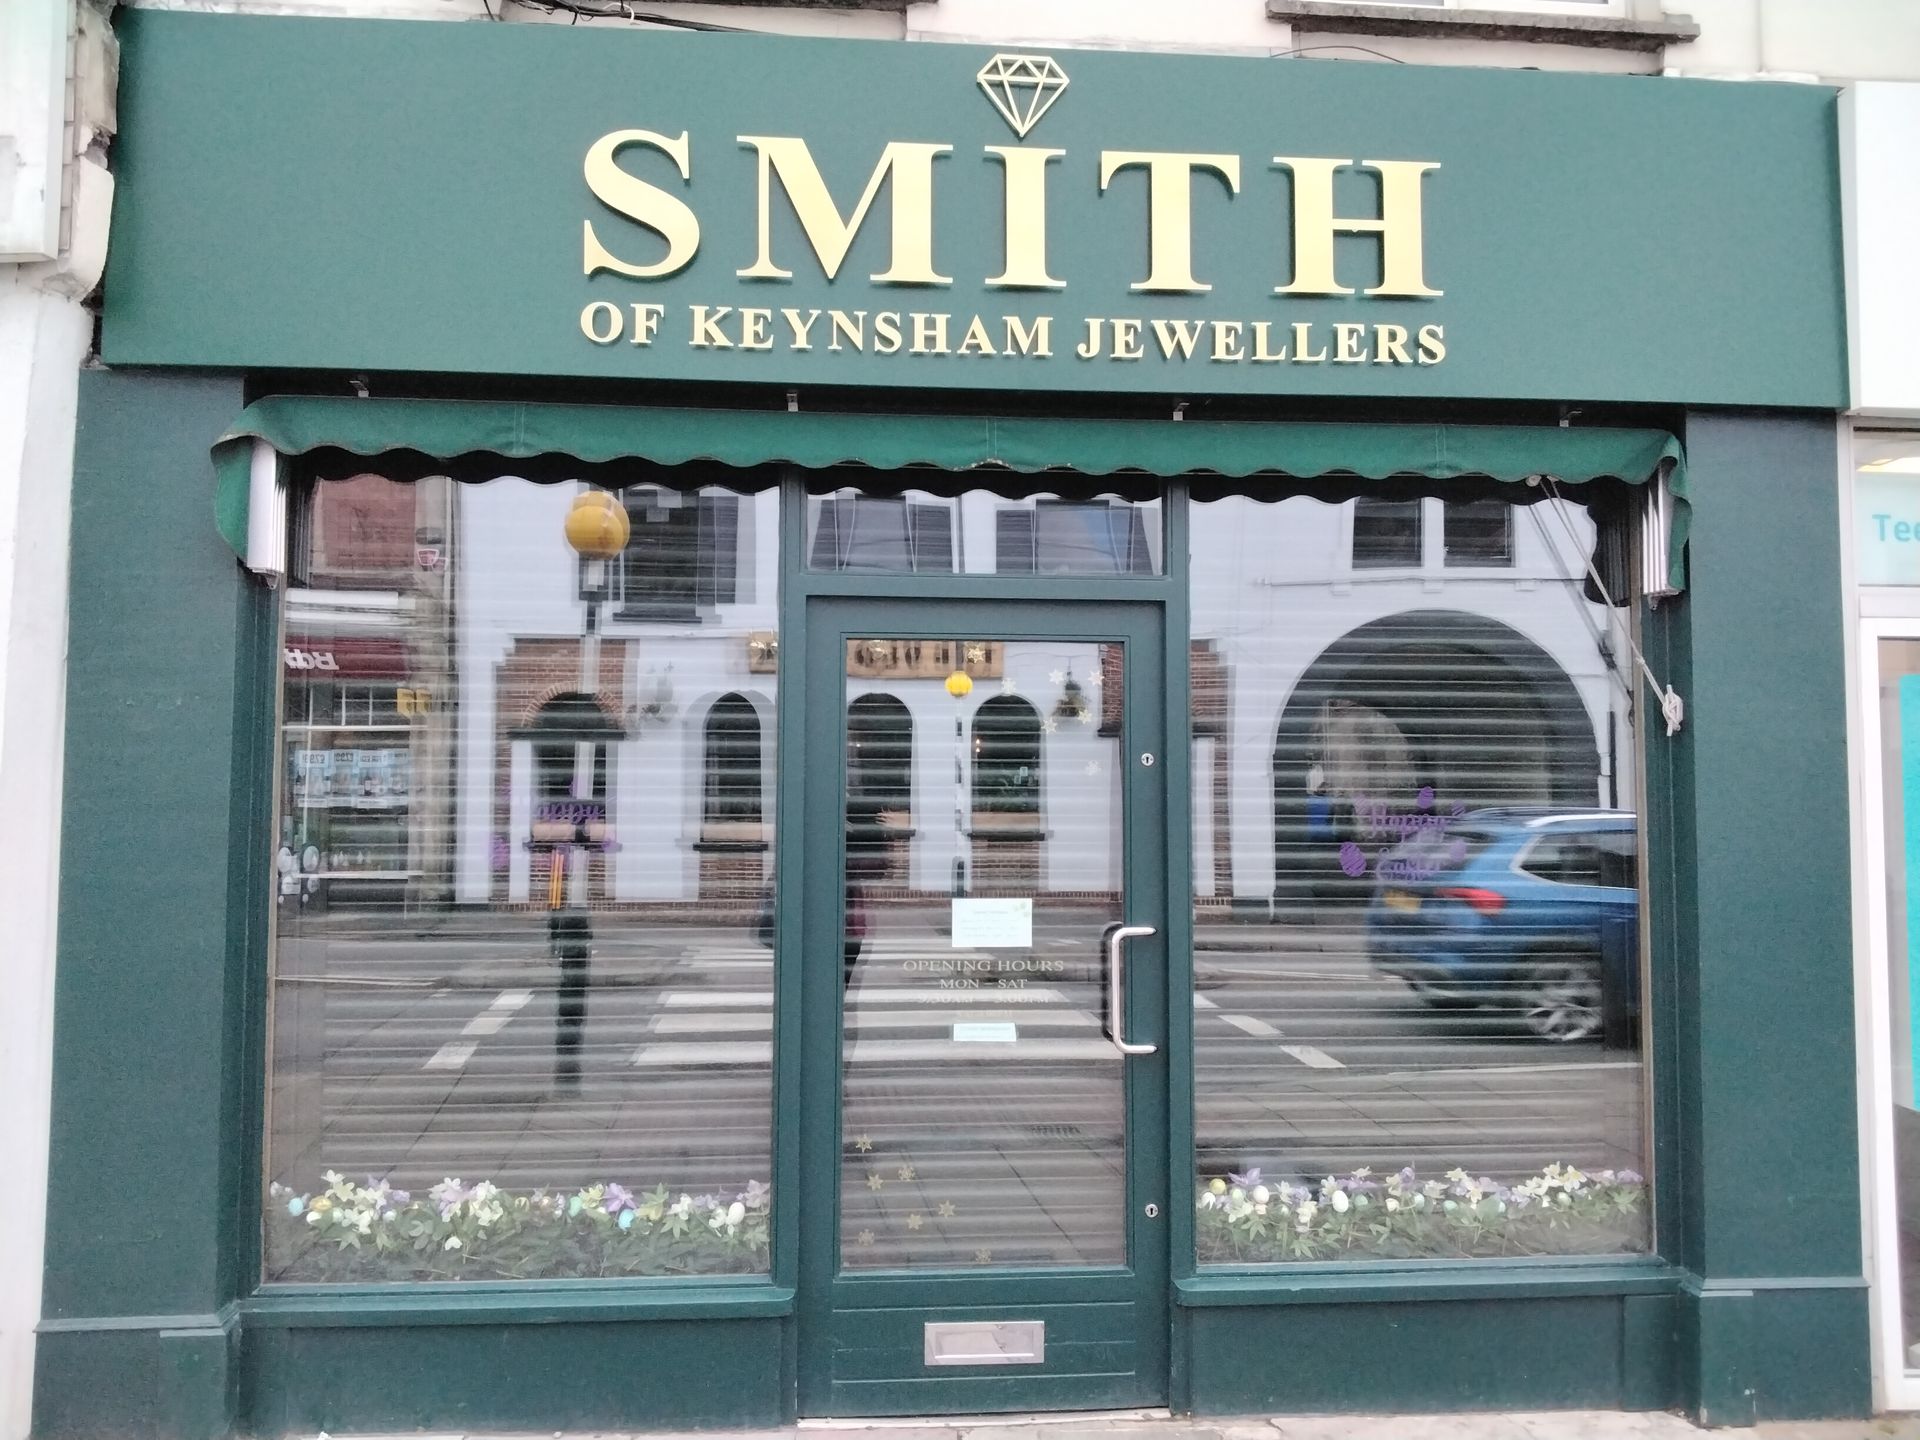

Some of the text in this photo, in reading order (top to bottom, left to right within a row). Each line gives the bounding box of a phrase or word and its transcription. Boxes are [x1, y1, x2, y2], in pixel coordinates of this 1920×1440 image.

[584, 129, 1443, 297] SMITH
[580, 301, 1446, 366] OF KEYNSHAM JEWELLERS
[903, 960, 1064, 972] OPENING HOURS
[940, 979, 979, 989] MON
[997, 979, 1028, 989] SAT
